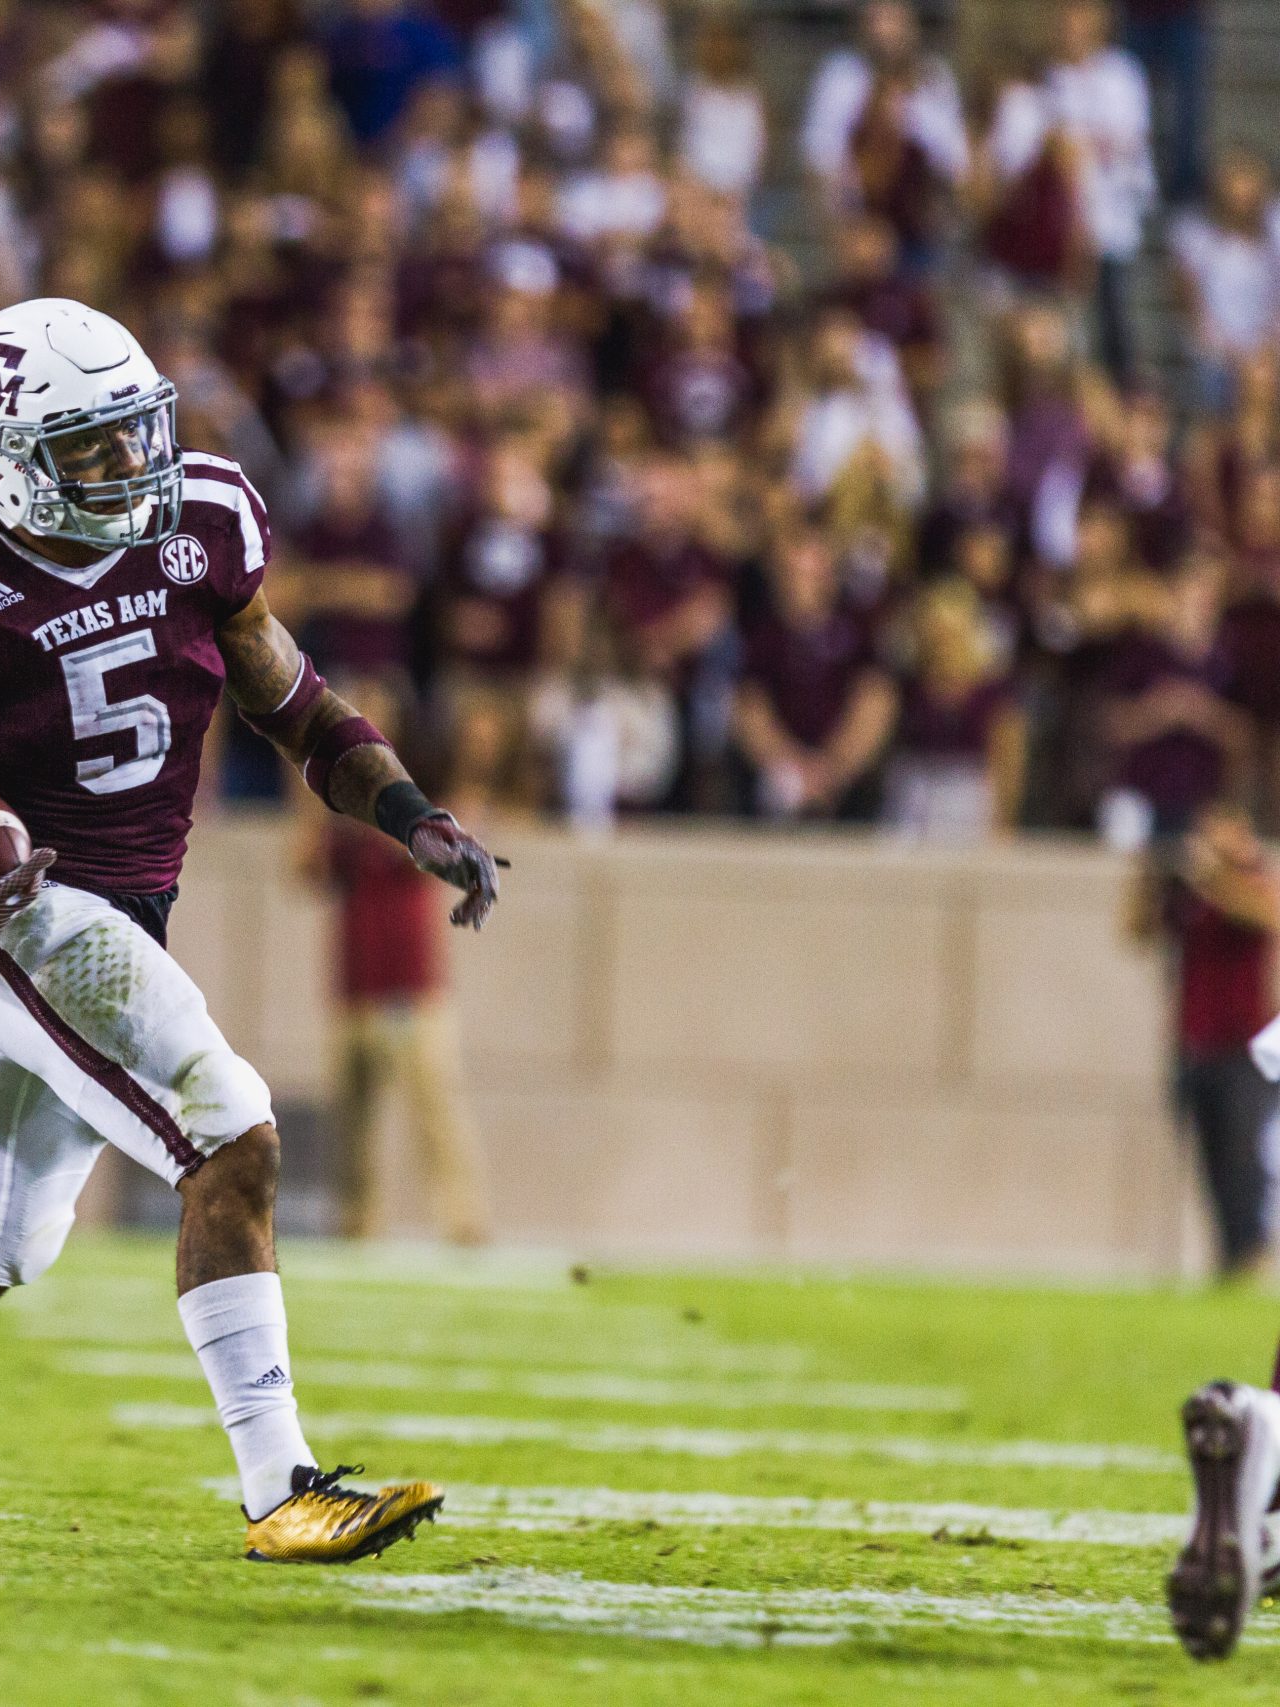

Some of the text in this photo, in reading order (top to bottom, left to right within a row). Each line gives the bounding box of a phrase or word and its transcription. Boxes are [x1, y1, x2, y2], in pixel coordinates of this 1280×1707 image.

[164, 539, 204, 580] SEC
[30, 588, 168, 652] TEXAS A&M
[60, 628, 172, 796] 5
